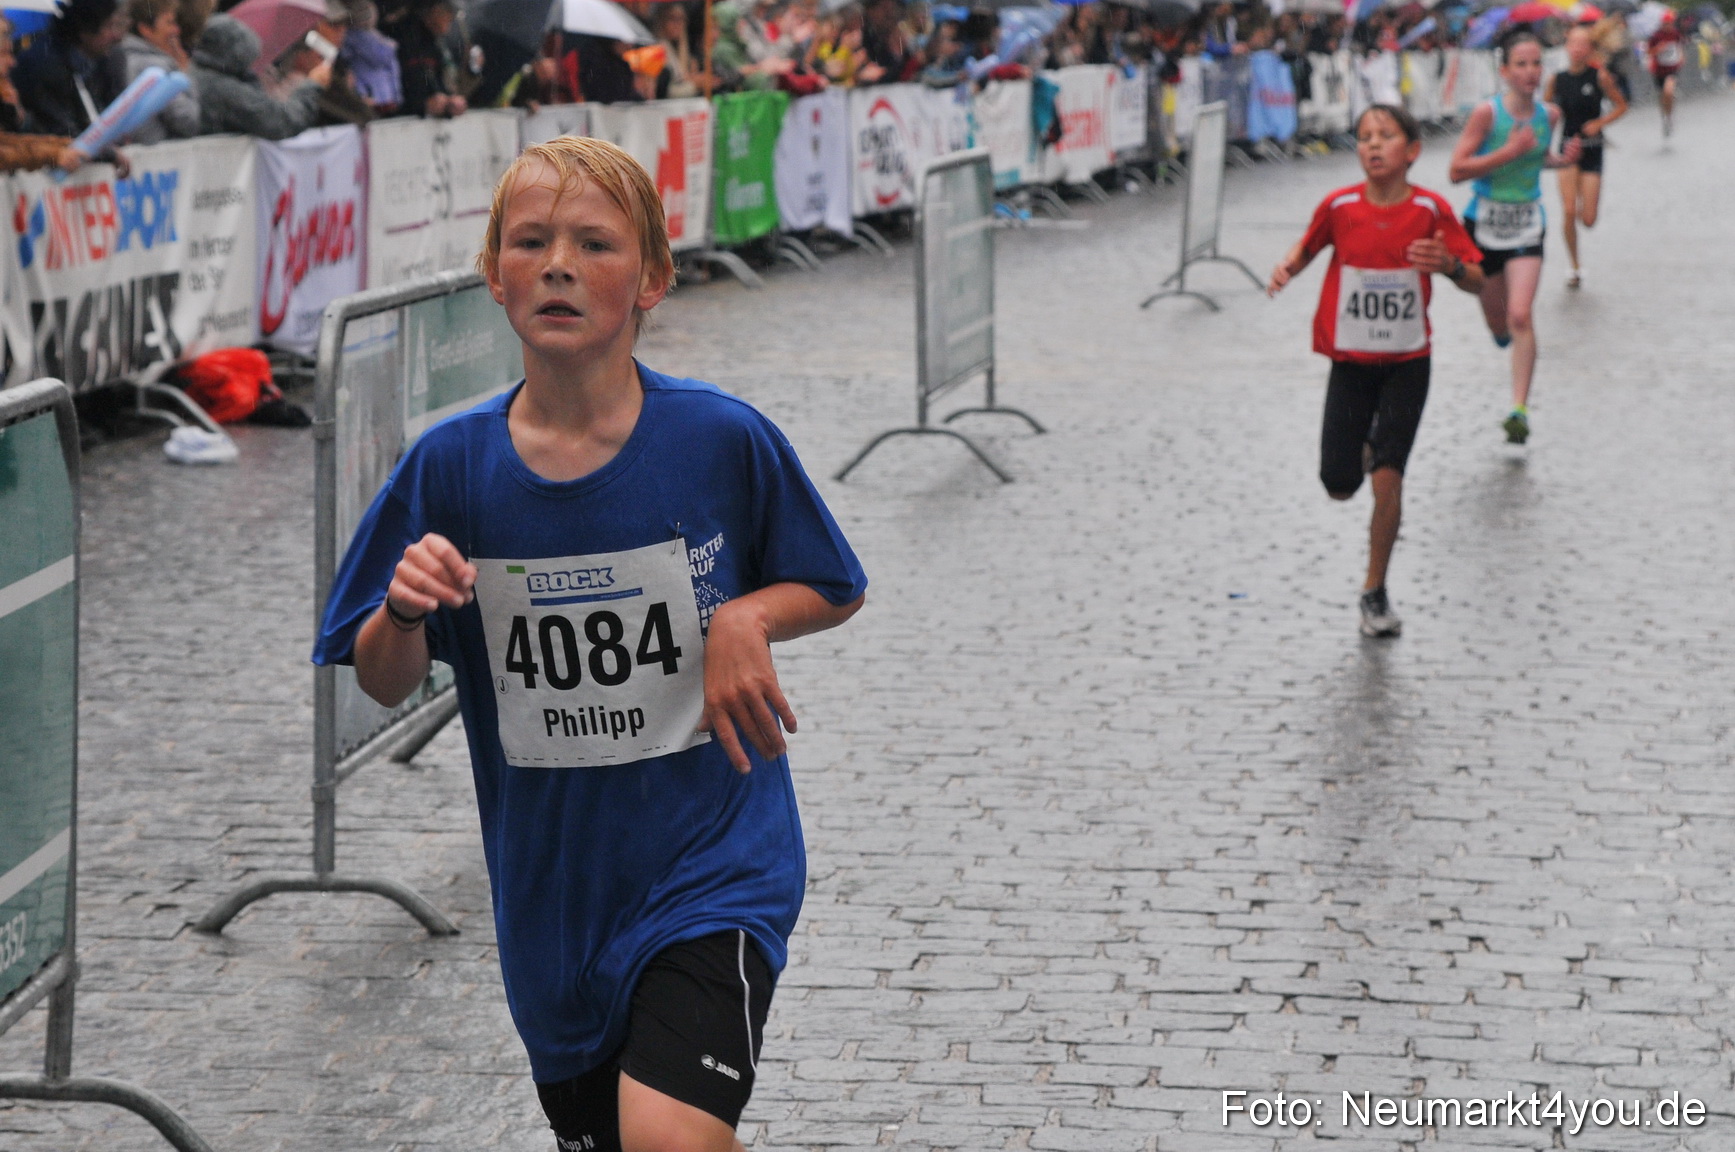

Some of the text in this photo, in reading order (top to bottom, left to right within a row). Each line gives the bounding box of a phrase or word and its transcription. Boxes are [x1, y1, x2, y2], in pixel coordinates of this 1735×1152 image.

[1346, 289, 1416, 321] 4062
[689, 532, 725, 563] RKTER
[527, 567, 616, 593] BOCK
[689, 557, 715, 578] AUF
[505, 601, 683, 691] 4084
[543, 705, 646, 741] Philipp
